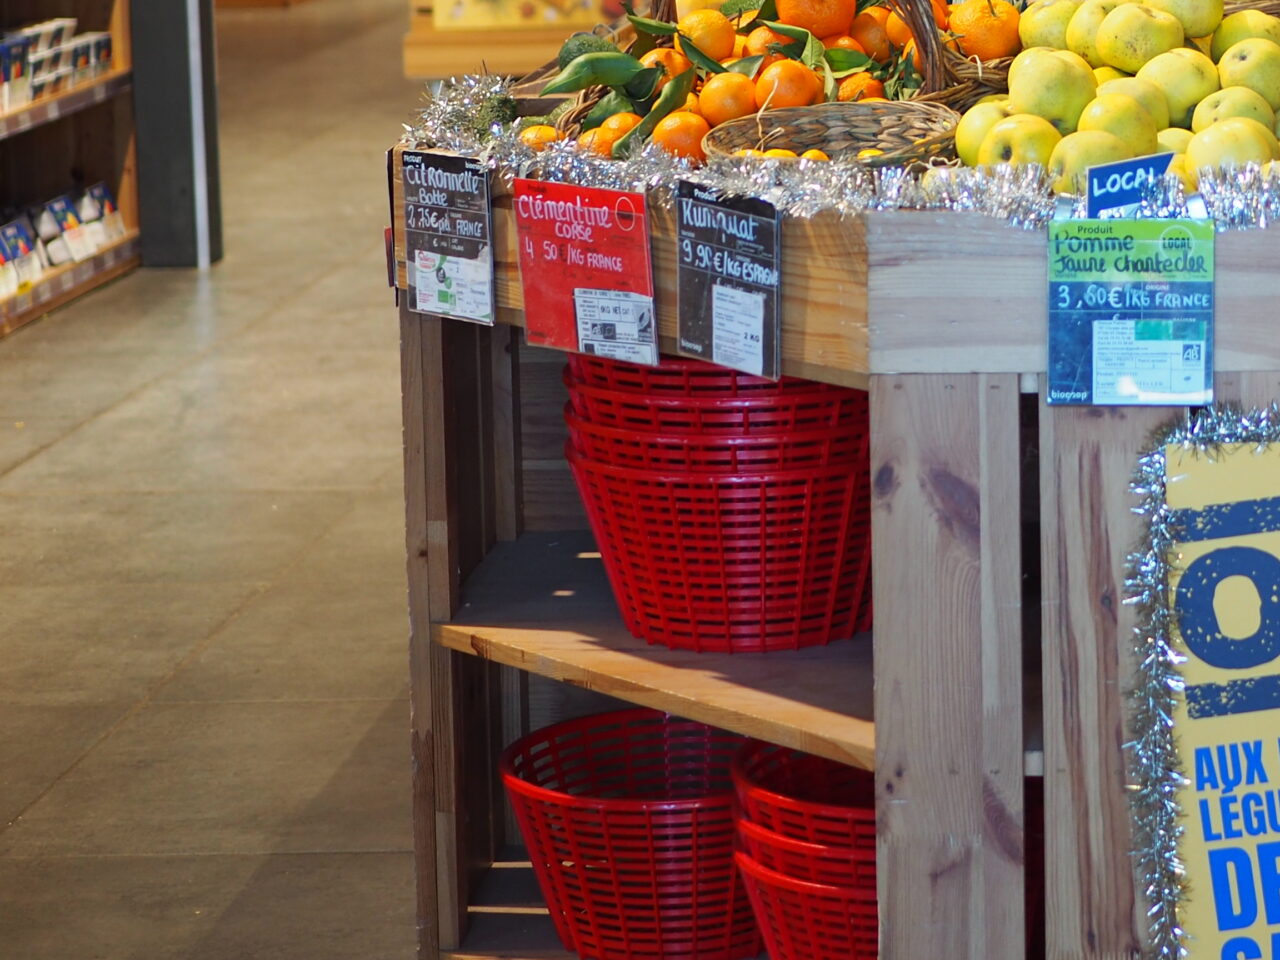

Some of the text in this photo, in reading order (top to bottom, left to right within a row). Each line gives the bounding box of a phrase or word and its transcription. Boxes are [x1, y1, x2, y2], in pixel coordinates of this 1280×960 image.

[1077, 225, 1113, 234] Produit
[1055, 230, 1193, 254] Pomme LOCAL
[1155, 292, 1211, 308] FRANCE
[1193, 739, 1268, 792] AUX
